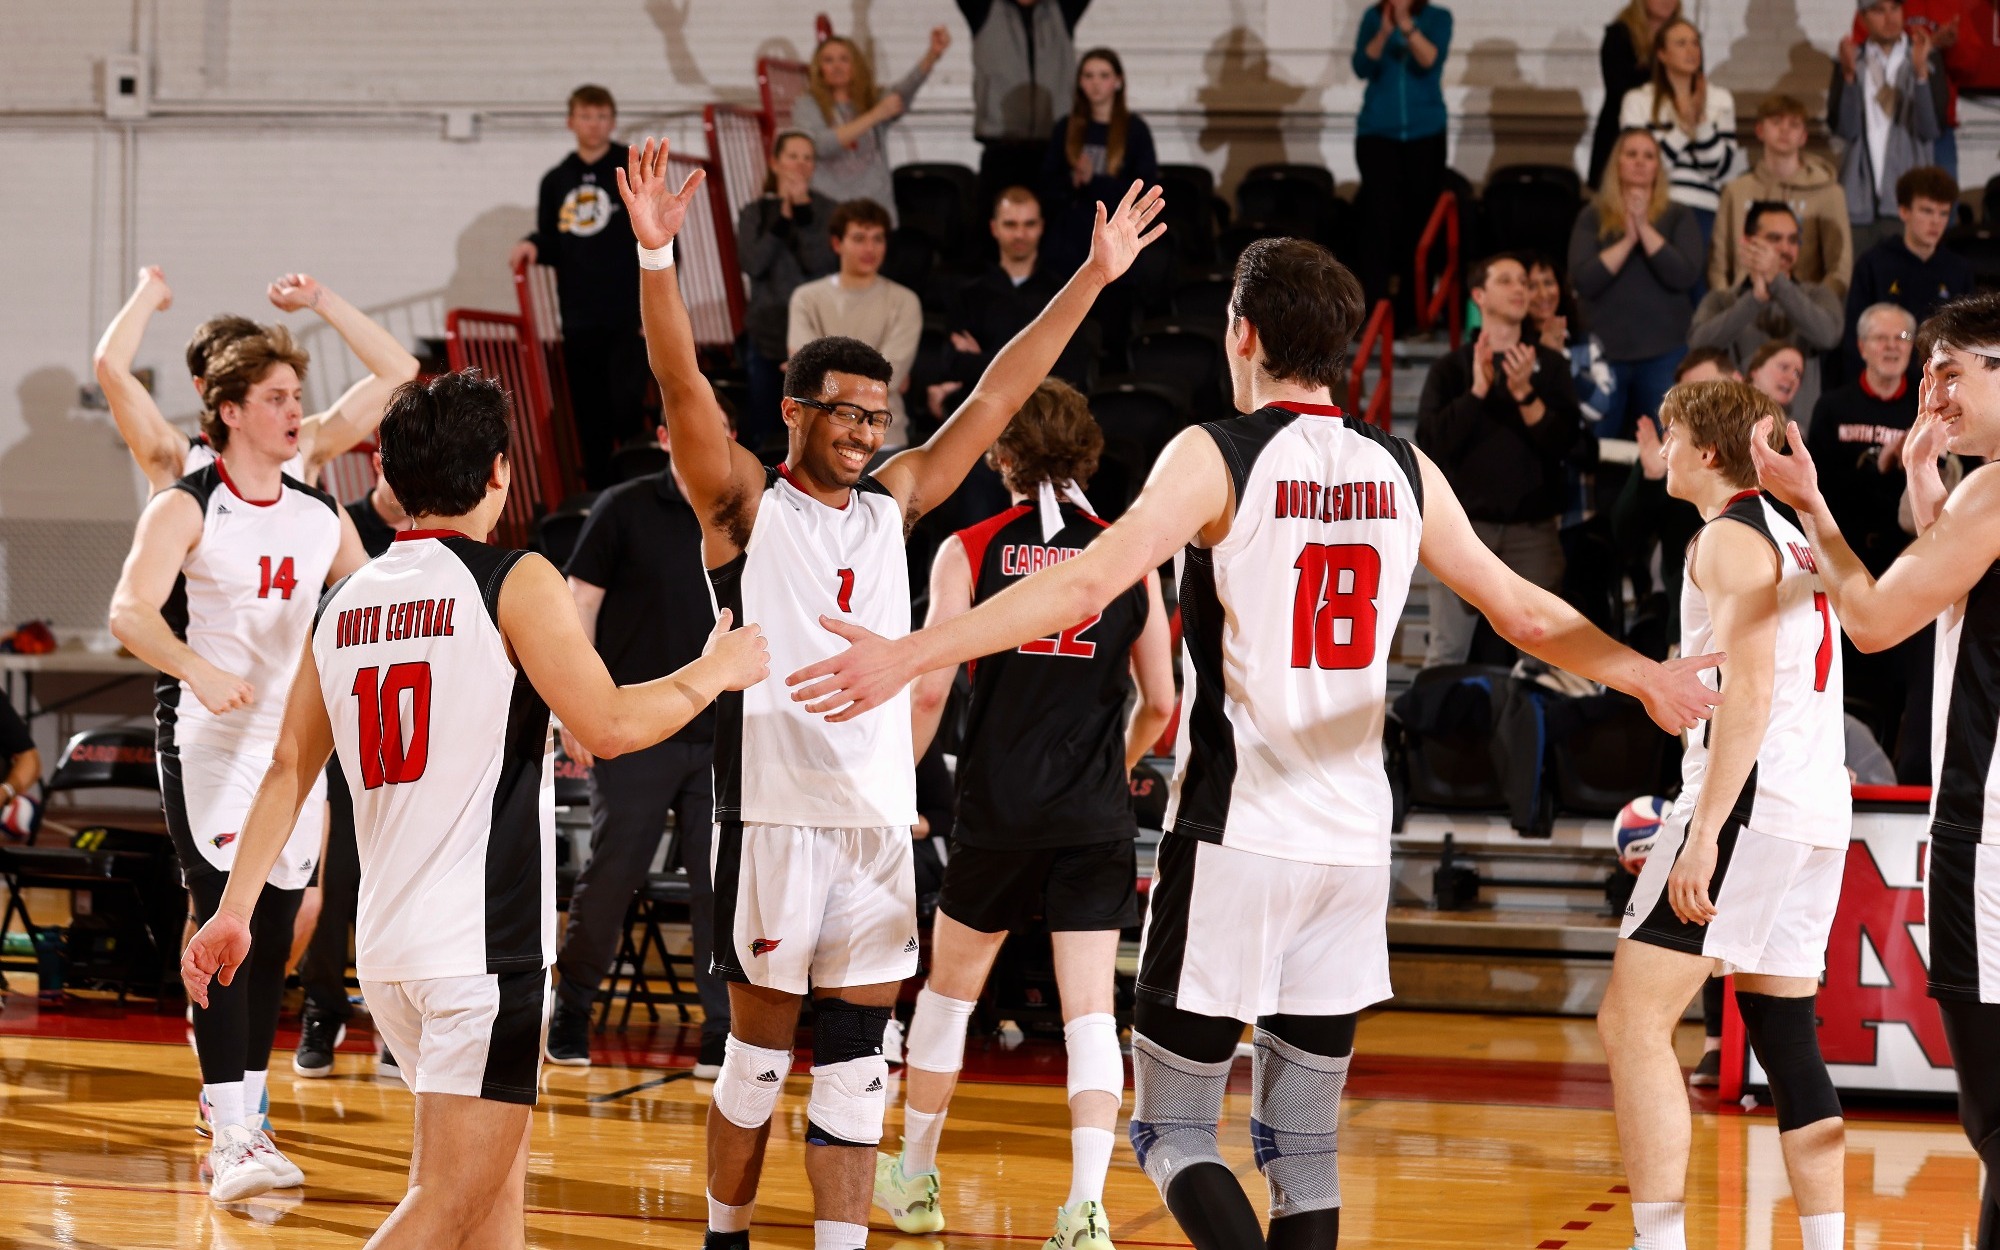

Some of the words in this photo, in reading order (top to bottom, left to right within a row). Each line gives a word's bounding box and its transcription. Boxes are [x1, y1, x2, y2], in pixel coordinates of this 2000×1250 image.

[1323, 481, 1398, 523] CENTRAL
[257, 555, 299, 600] 14
[336, 605, 382, 649] NORTH
[386, 598, 456, 641] CENTRAL
[1291, 542, 1382, 670] 18
[351, 660, 433, 791] 10
